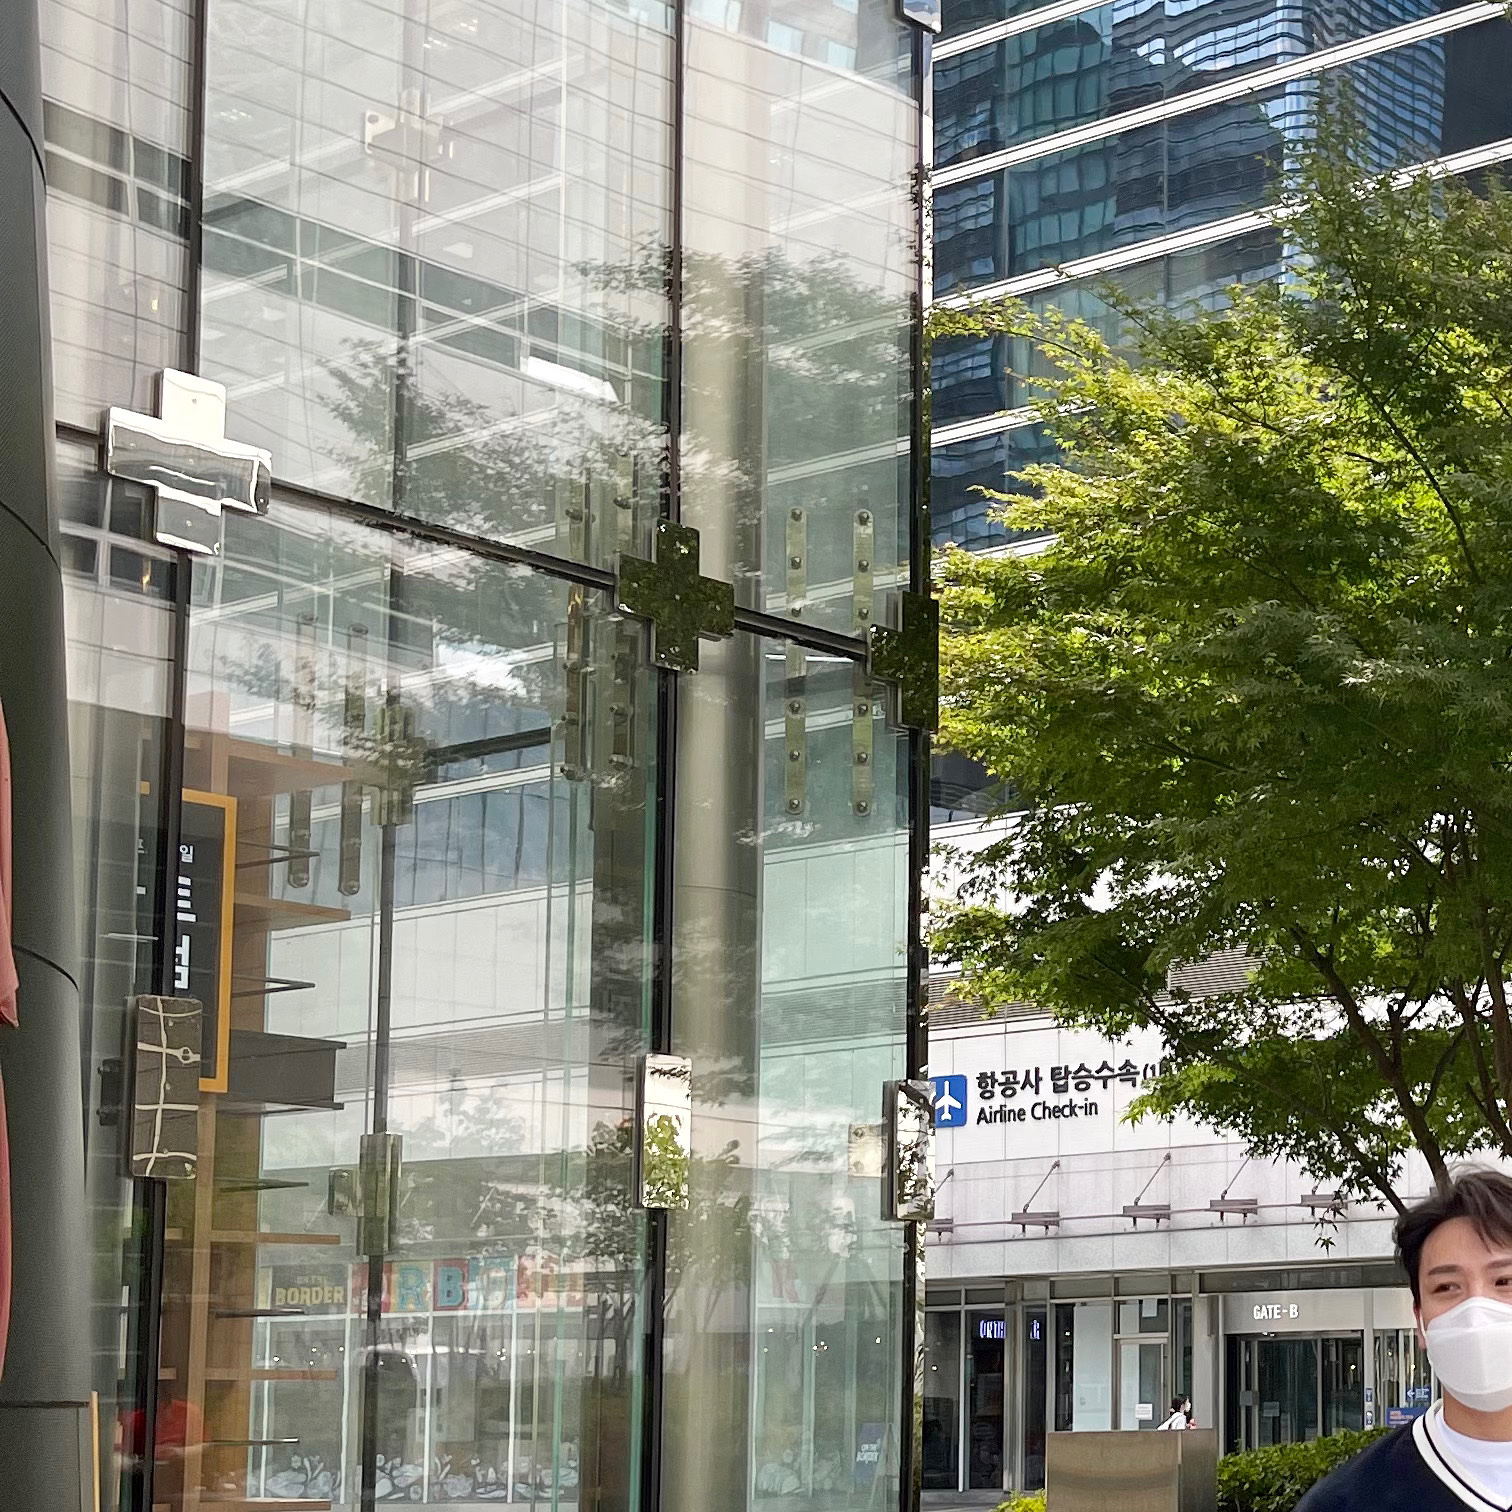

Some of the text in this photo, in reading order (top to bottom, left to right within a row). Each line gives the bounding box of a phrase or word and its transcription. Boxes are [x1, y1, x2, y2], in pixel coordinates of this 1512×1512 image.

[976, 1066, 1042, 1100] 항공사
[1050, 1059, 1140, 1094] 탑승수속
[976, 1098, 1098, 1125] Airline Check-in
[275, 1286, 345, 1306] BORDER
